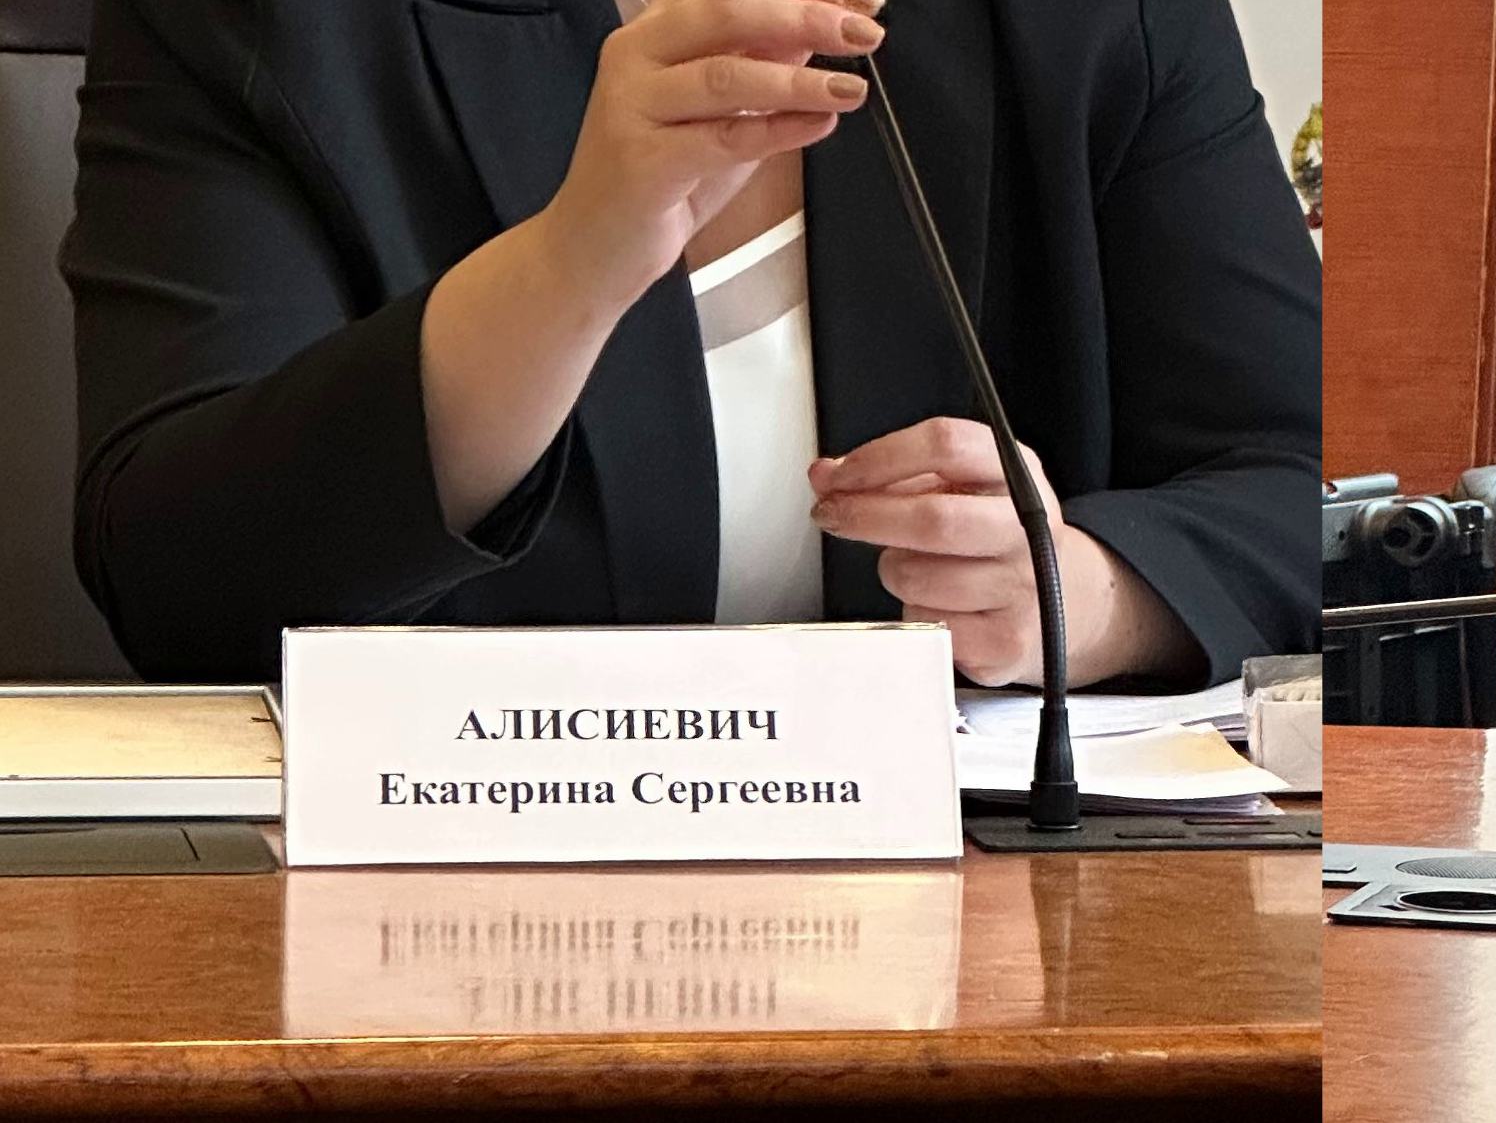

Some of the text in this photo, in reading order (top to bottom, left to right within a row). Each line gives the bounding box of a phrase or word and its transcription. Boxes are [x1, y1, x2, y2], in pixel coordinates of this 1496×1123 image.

[455, 709, 779, 741] АЛИСИЕВИЧ
[378, 771, 861, 813] Екатерина Сергеевна
